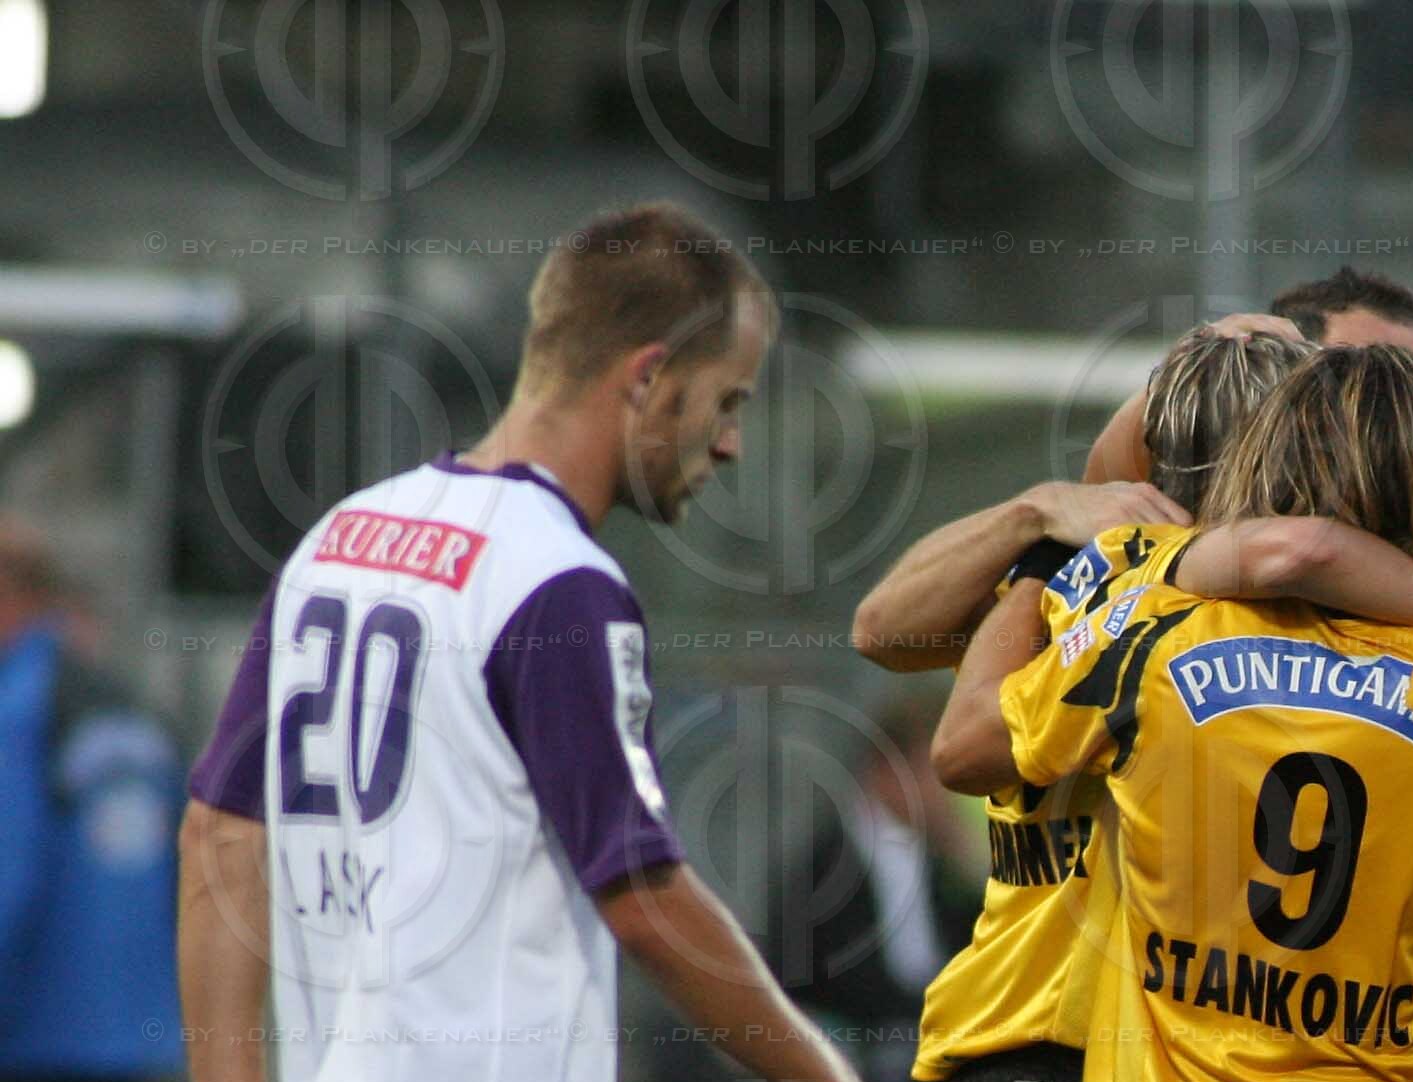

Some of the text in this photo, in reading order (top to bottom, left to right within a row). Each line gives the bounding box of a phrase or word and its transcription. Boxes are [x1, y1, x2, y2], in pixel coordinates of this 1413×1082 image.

[319, 514, 471, 579] KURIER
[278, 594, 424, 824] 20
[1247, 751, 1368, 950] 9
